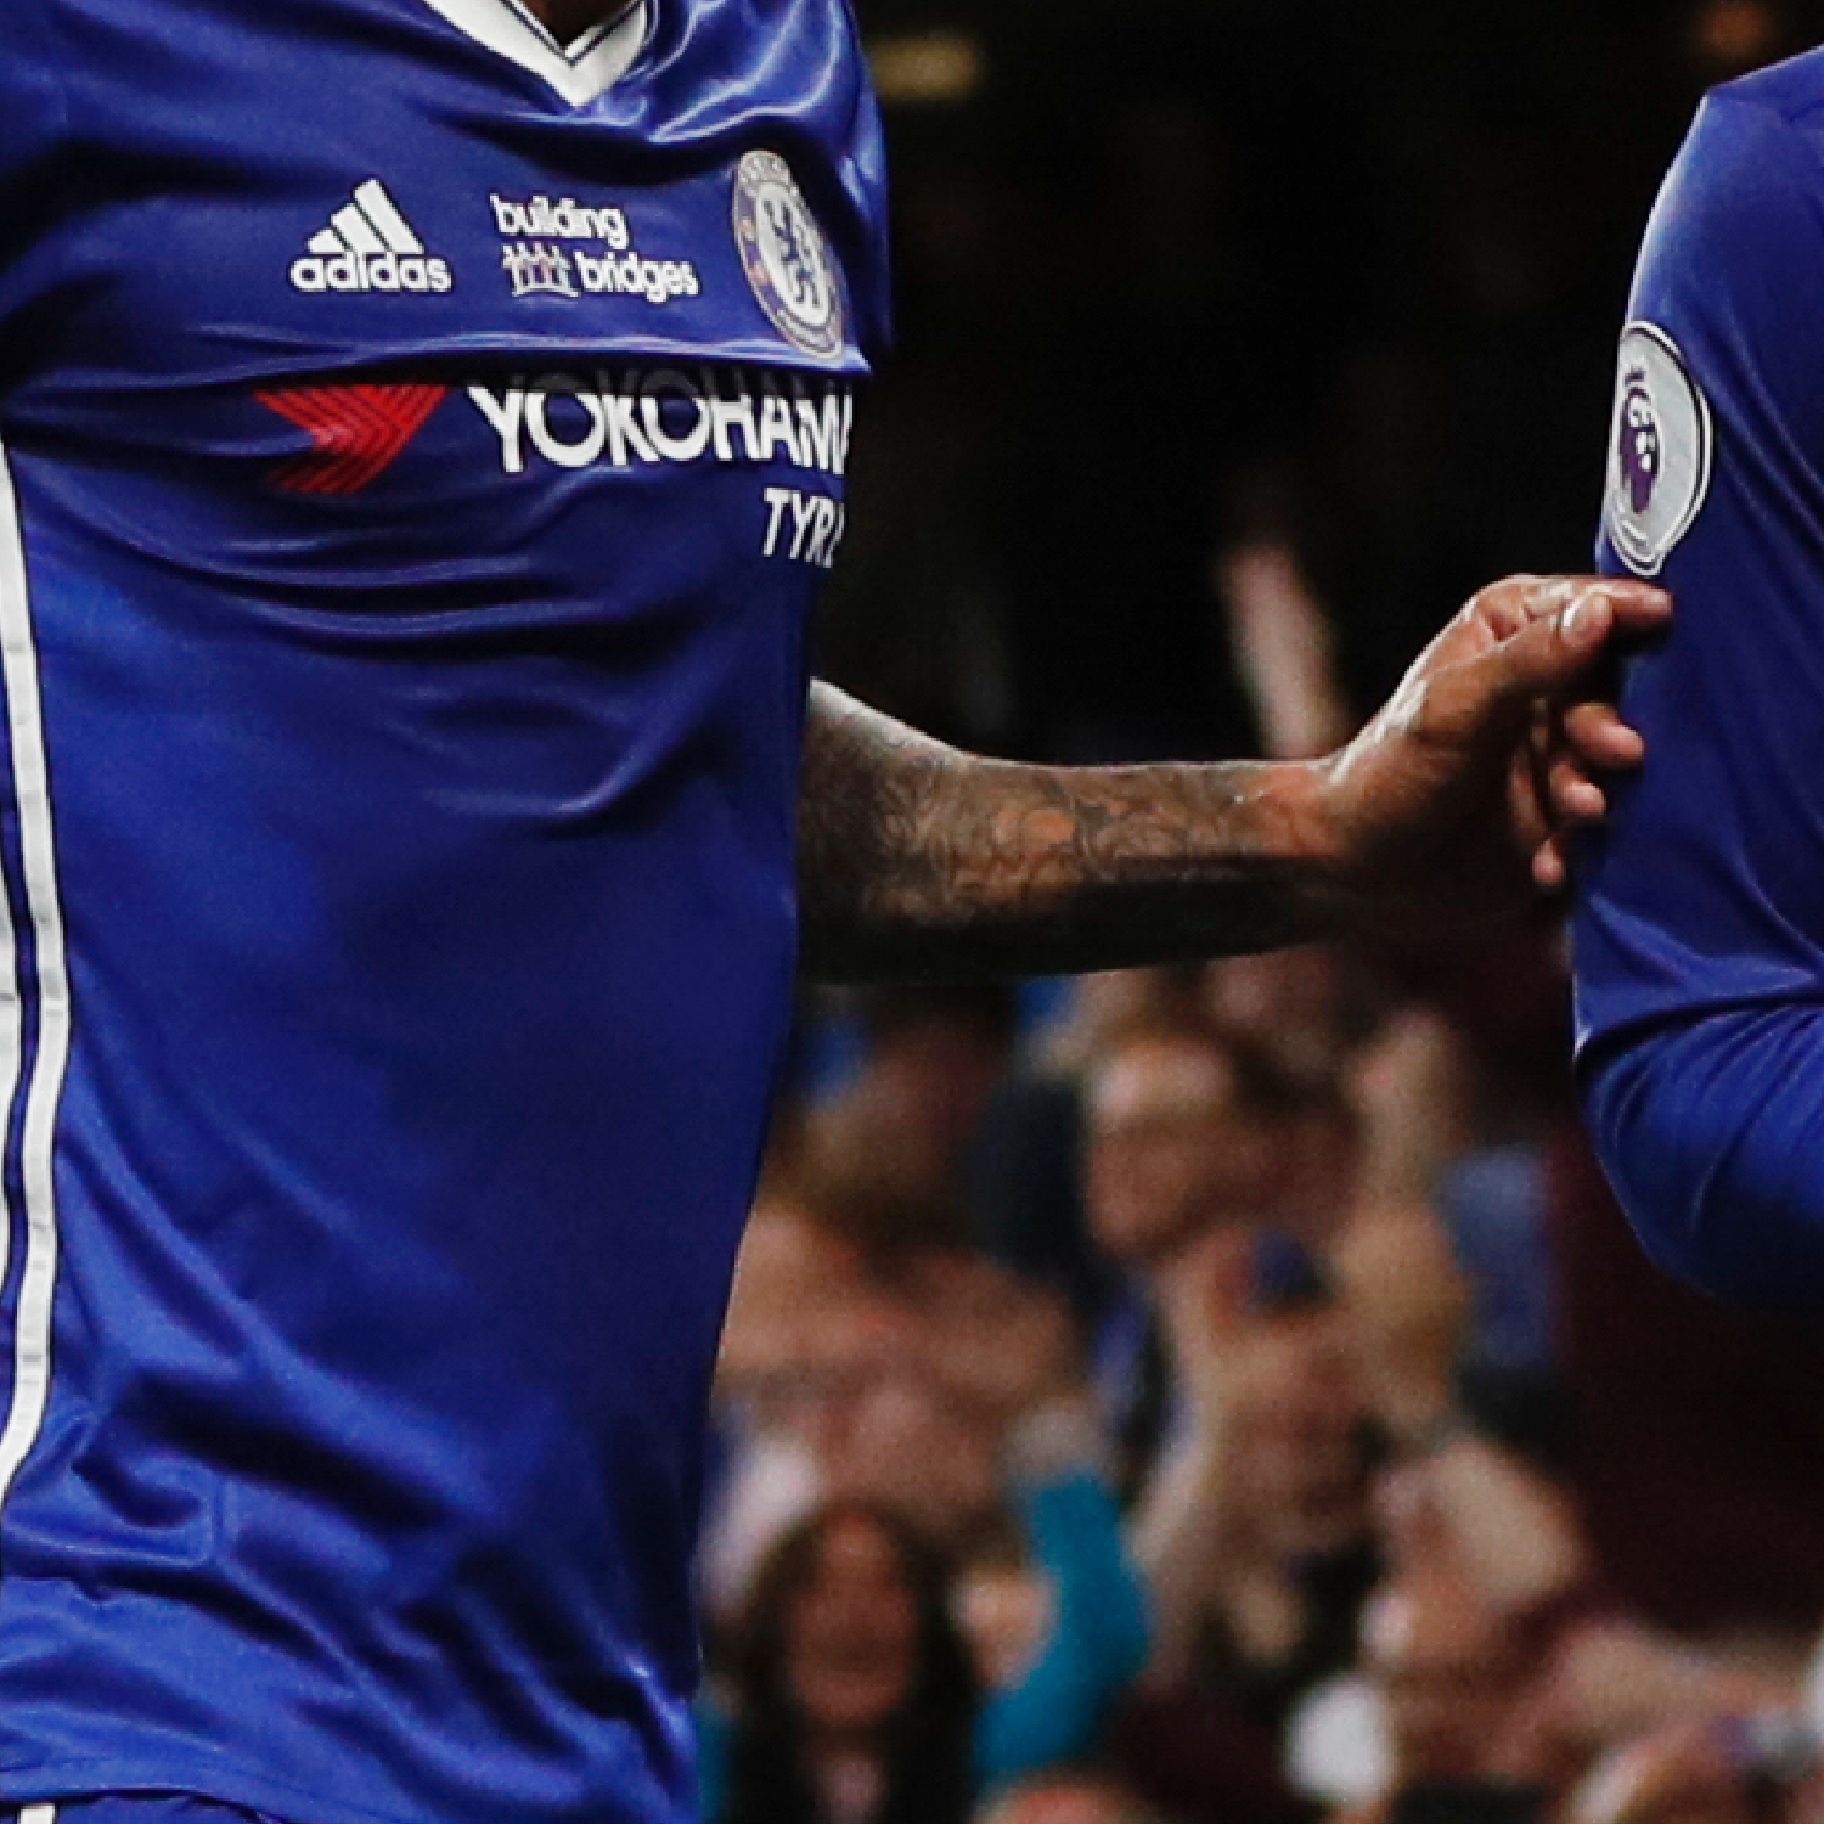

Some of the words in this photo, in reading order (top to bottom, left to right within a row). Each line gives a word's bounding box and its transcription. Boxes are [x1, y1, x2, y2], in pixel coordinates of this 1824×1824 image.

[489, 194, 630, 250] building
[289, 250, 453, 293] adidas
[572, 246, 700, 303] bridges
[466, 369, 854, 474] YOKOHAM
[761, 487, 846, 569] TYR
